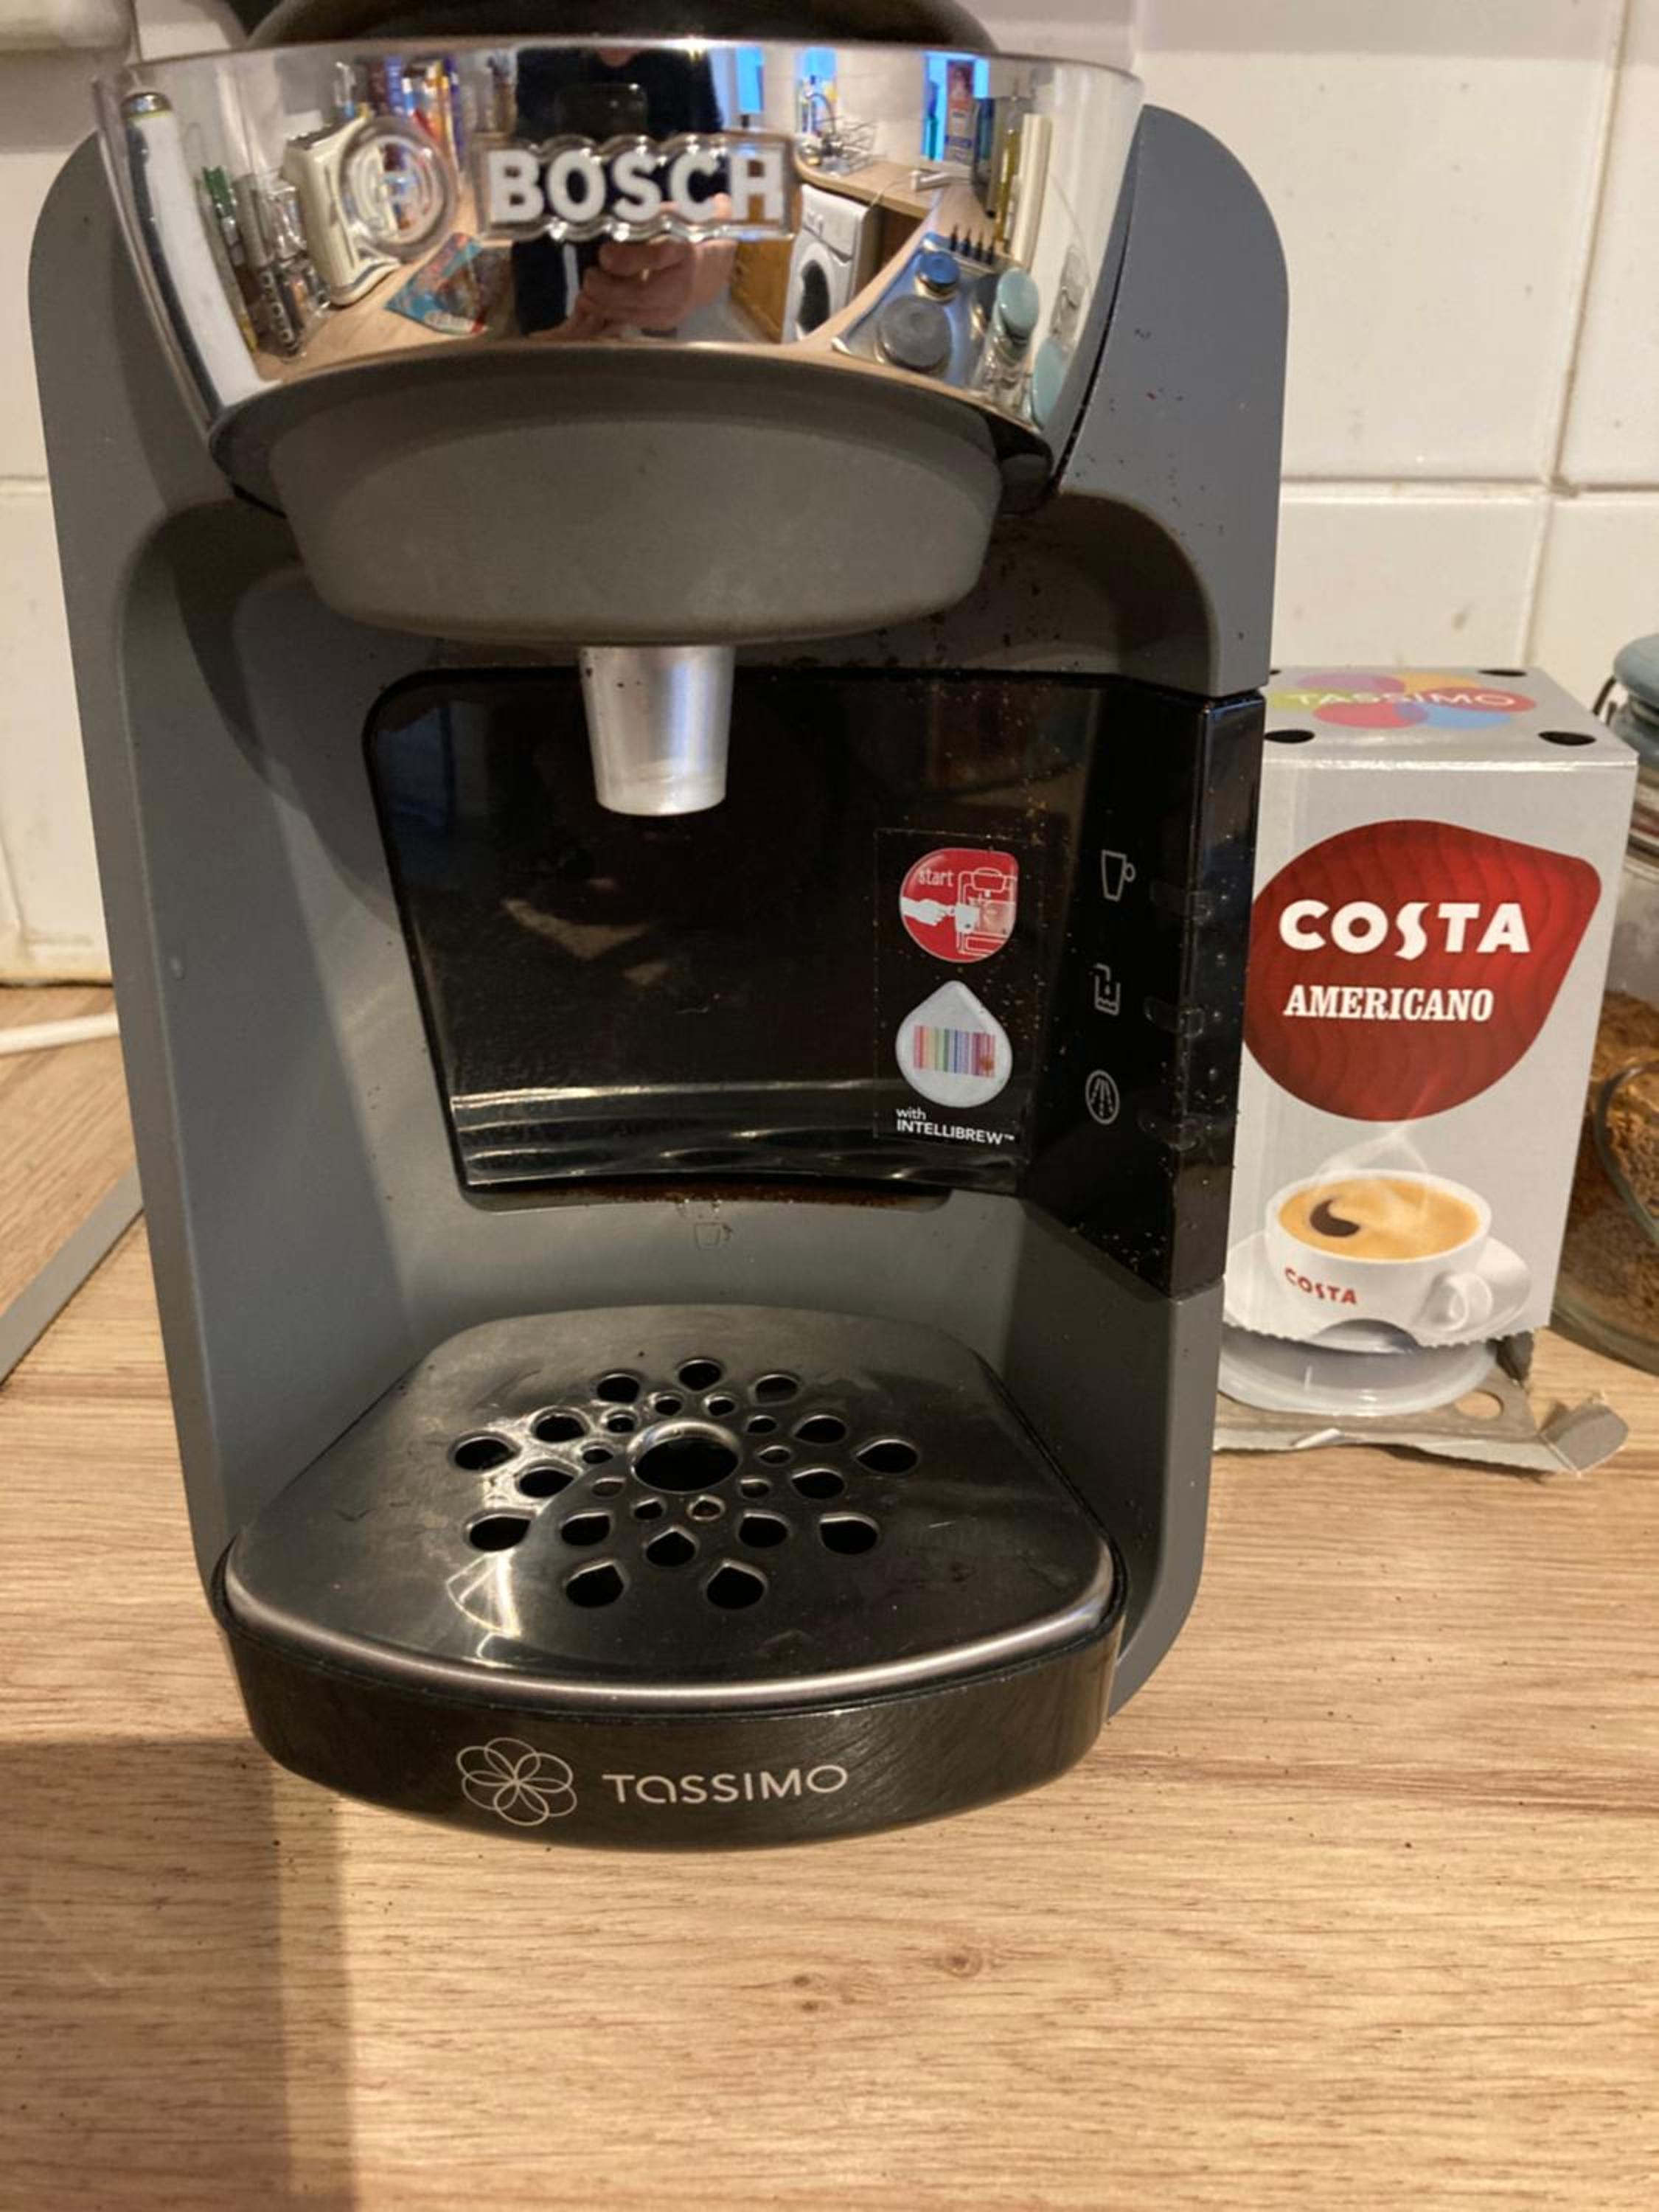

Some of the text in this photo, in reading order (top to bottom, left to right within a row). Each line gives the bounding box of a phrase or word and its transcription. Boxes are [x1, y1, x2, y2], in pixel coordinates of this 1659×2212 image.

[489, 147, 785, 222] BOSCH
[1286, 692, 1516, 706] TASSIMO
[919, 867, 953, 887] start
[1279, 900, 1531, 961] COSTA
[1283, 985, 1495, 1023] AMERICANO
[896, 1107, 927, 1120] with
[1284, 1267, 1357, 1305] COSTA
